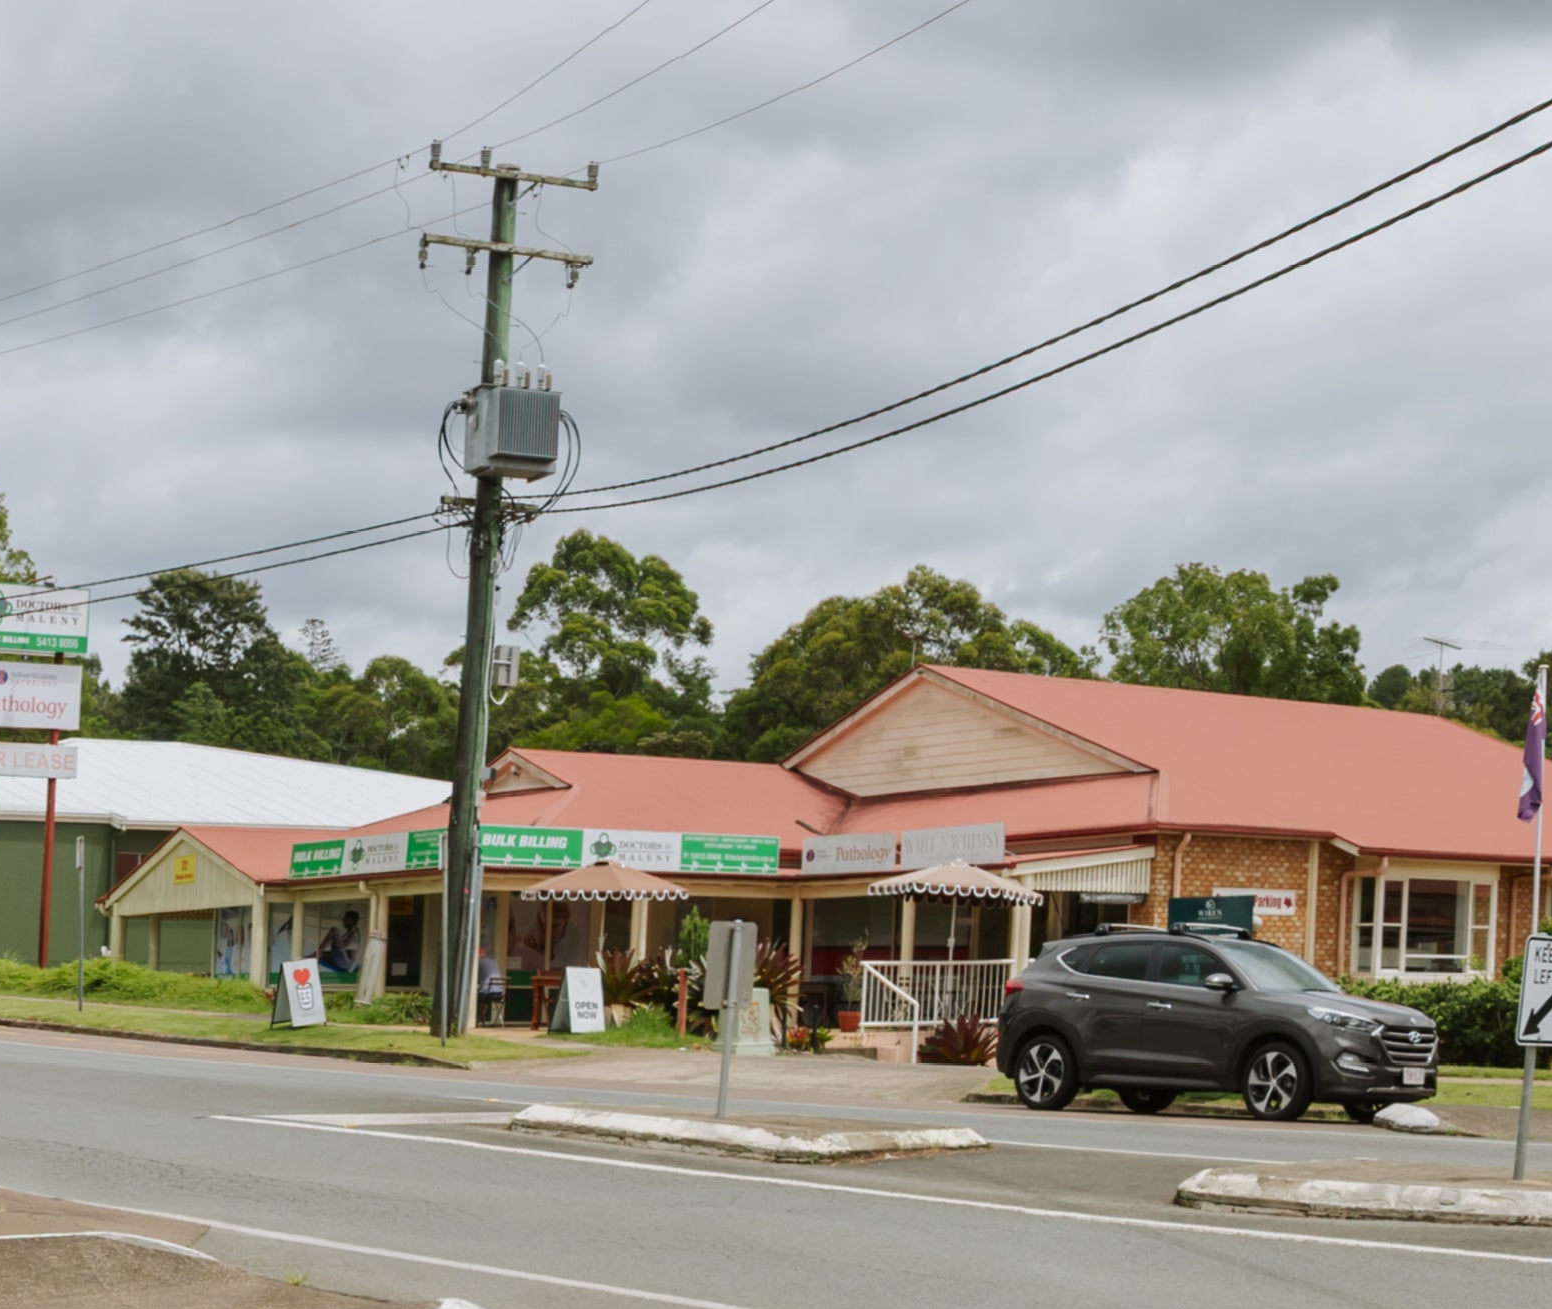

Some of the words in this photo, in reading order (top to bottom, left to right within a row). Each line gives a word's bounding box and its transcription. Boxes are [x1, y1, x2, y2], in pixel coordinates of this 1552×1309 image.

[15, 612, 79, 626] MALENY
[36, 636, 57, 648] 5413
[13, 750, 75, 771] LEASE
[482, 832, 516, 847] BULK
[519, 834, 568, 849] BILLING
[618, 840, 663, 850] DOCTORS
[618, 853, 671, 863] MALENY
[835, 844, 891, 864] Pathology
[1253, 895, 1282, 909] Parking
[574, 1001, 598, 1010] OPEN
[577, 1010, 597, 1019] NOW
